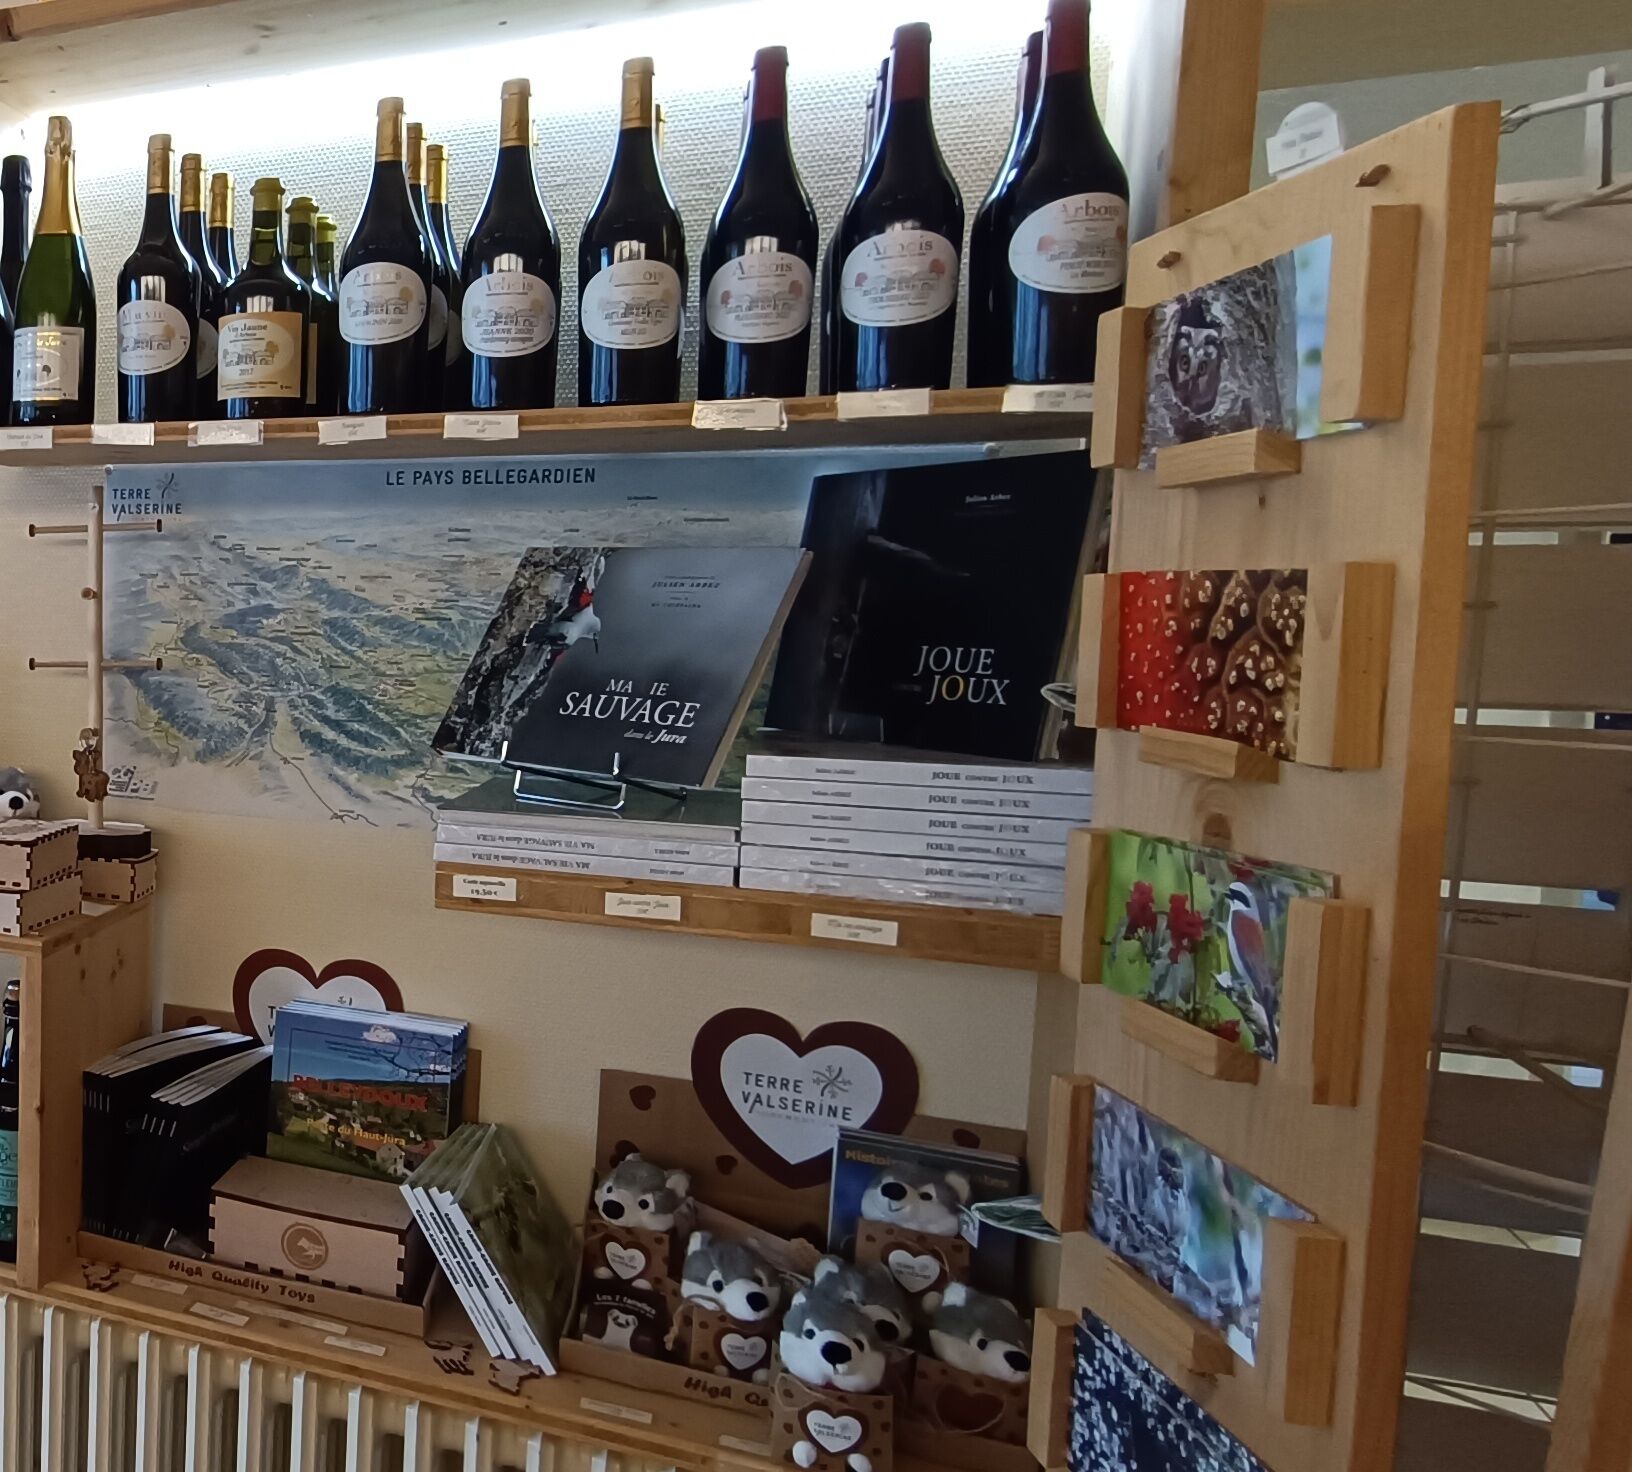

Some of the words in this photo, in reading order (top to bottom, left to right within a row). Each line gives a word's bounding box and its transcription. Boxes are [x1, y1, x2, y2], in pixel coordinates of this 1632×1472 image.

[386, 470, 405, 485] LE
[412, 470, 454, 485] PAYS
[462, 468, 596, 485] BELLEGARDIEN
[112, 488, 151, 500] TERRE
[112, 503, 182, 521] VALSERINE
[913, 645, 995, 676] JOUE
[606, 679, 633, 693] MA
[925, 675, 1011, 705] JOUX
[559, 691, 701, 728] SAUVAGE
[651, 729, 688, 744] Jura
[932, 771, 961, 781] JOUE
[928, 794, 958, 805] JOUE
[928, 819, 957, 829] JOUE
[926, 842, 955, 852] JOUE
[743, 1071, 804, 1094] TERRE
[741, 1090, 853, 1121] VALSERINE
[338, 1125, 351, 1136] du
[353, 1127, 407, 1146] Haut-Jura
[168, 1260, 203, 1278] High
[212, 1270, 270, 1294] Quality
[279, 1285, 315, 1303] Toys
[684, 1377, 732, 1399] High
